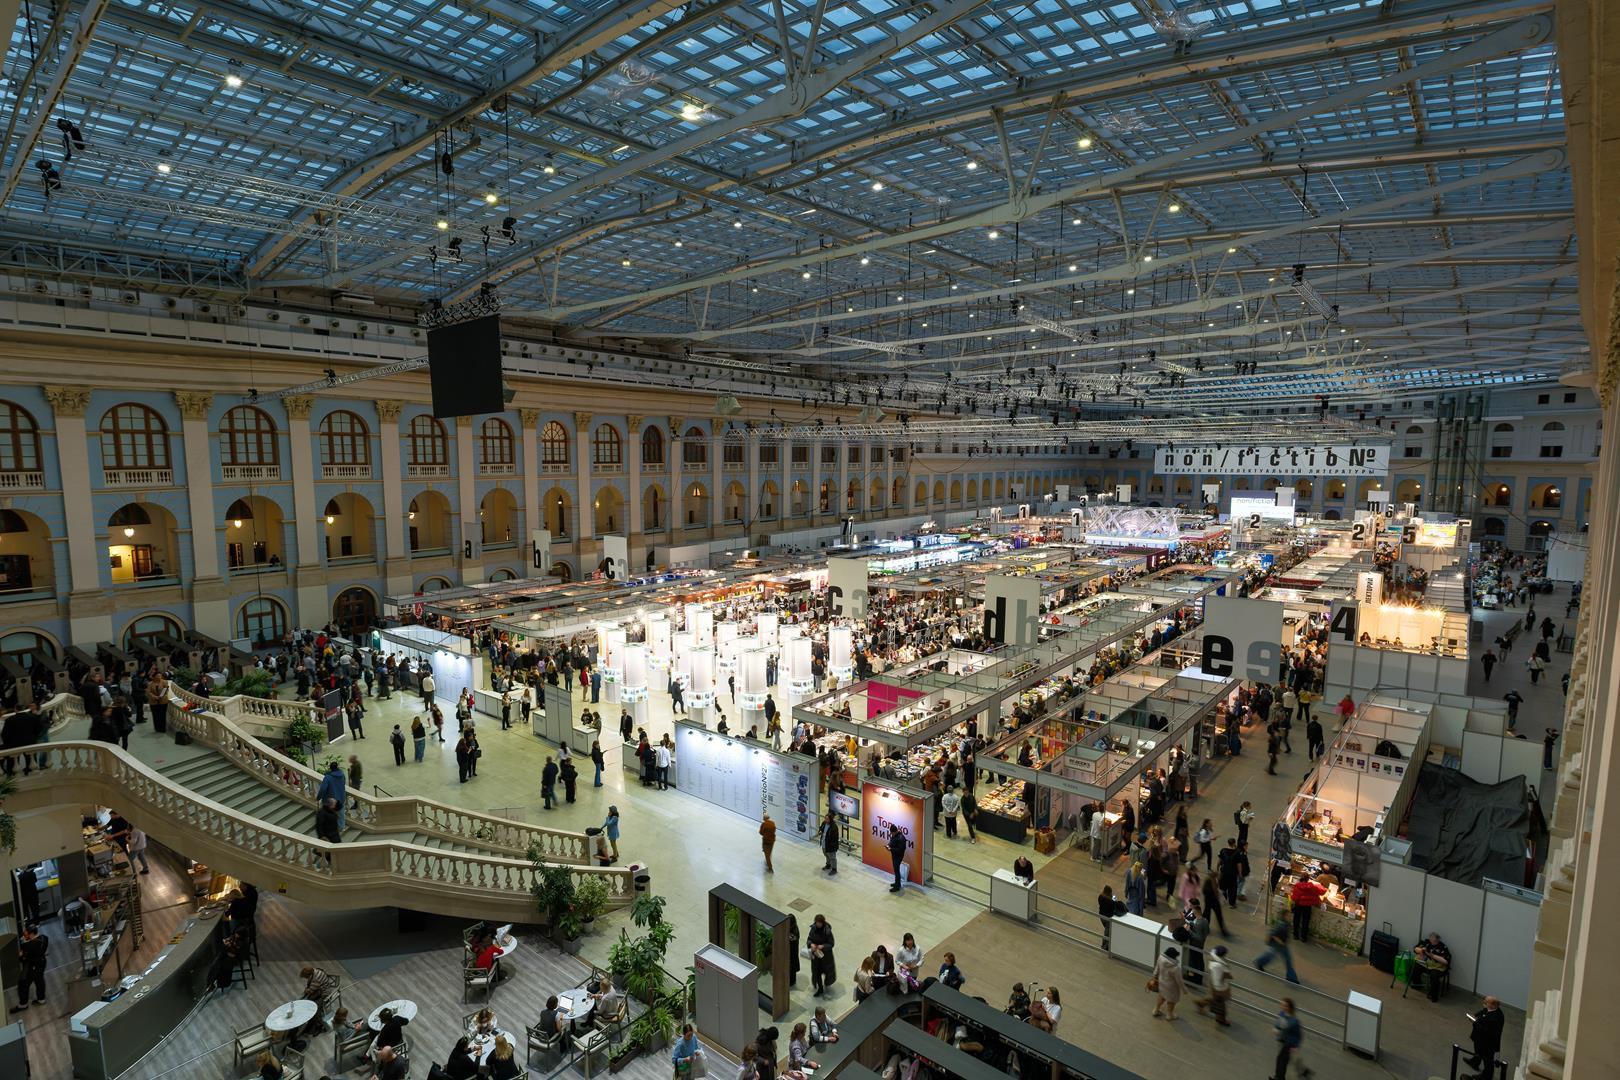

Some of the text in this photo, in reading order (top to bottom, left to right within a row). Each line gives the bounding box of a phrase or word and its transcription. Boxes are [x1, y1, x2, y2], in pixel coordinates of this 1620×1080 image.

[1250, 514, 1260, 528] 2
[1352, 524, 1364, 540] 2
[1403, 526, 1415, 544] 5
[605, 557, 615, 579] c
[828, 585, 843, 617] c
[1365, 577, 1374, 604] ЛЕКТОРИЙ
[984, 596, 1006, 643] d
[1331, 606, 1356, 642] 4
[1201, 635, 1234, 677] e
[872, 825, 878, 836] Я
[877, 815, 909, 836] Толко
